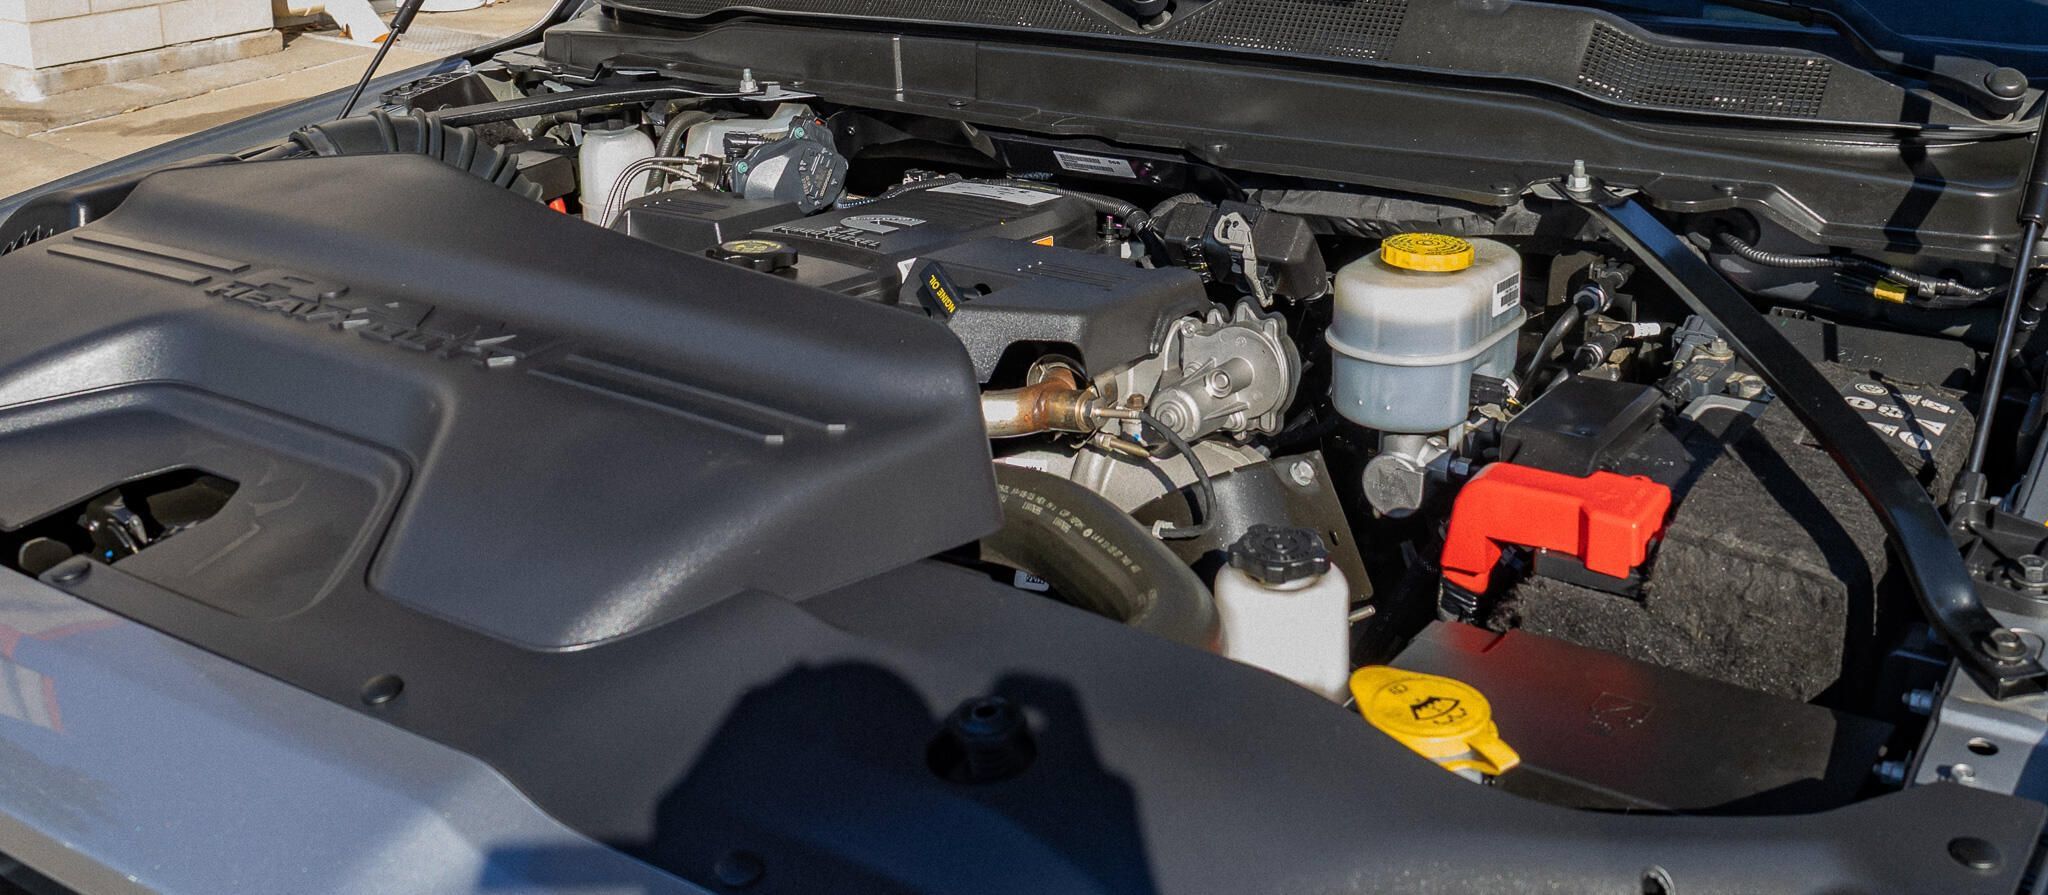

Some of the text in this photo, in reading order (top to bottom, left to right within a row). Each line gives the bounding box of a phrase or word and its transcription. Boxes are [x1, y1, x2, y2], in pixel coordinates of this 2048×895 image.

[203, 284, 370, 330] HEAVY
[929, 274, 956, 313] NGINE OIL
